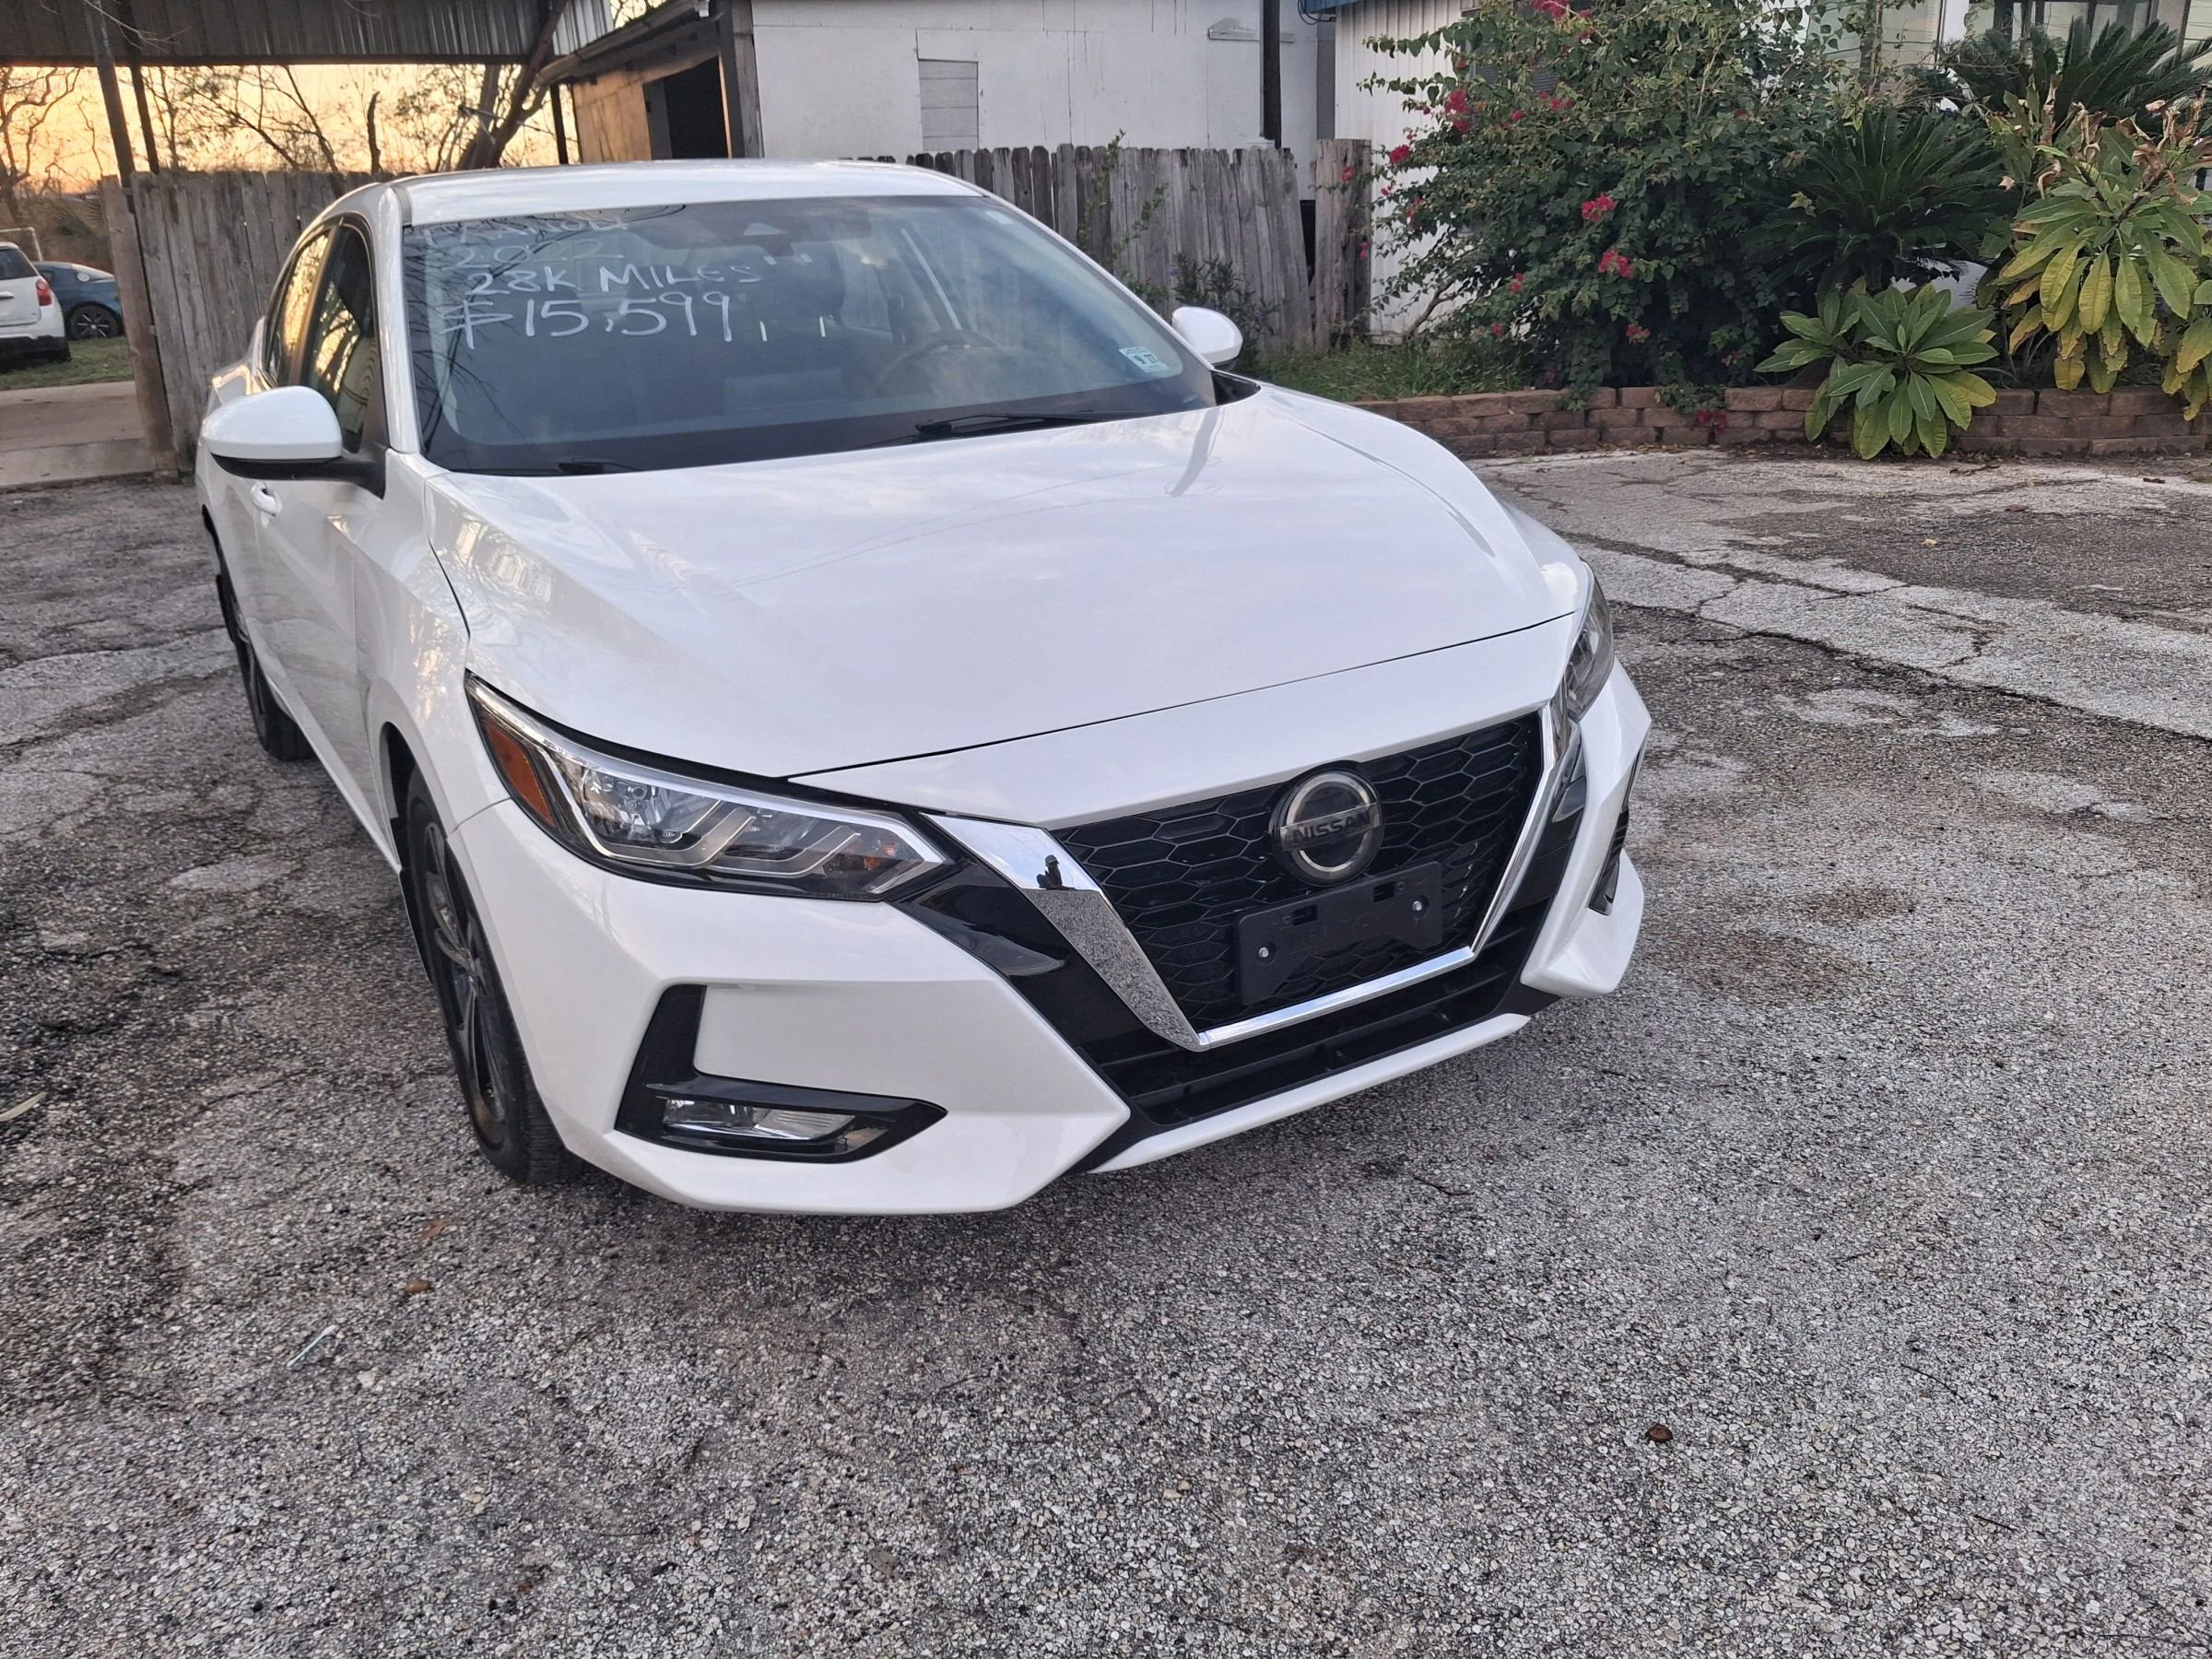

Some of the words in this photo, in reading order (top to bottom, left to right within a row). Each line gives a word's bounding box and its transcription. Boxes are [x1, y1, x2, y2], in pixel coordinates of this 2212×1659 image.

[465, 265, 582, 295] 28K
[599, 263, 763, 293] MILES
[1292, 810, 1371, 842] NISSAN
